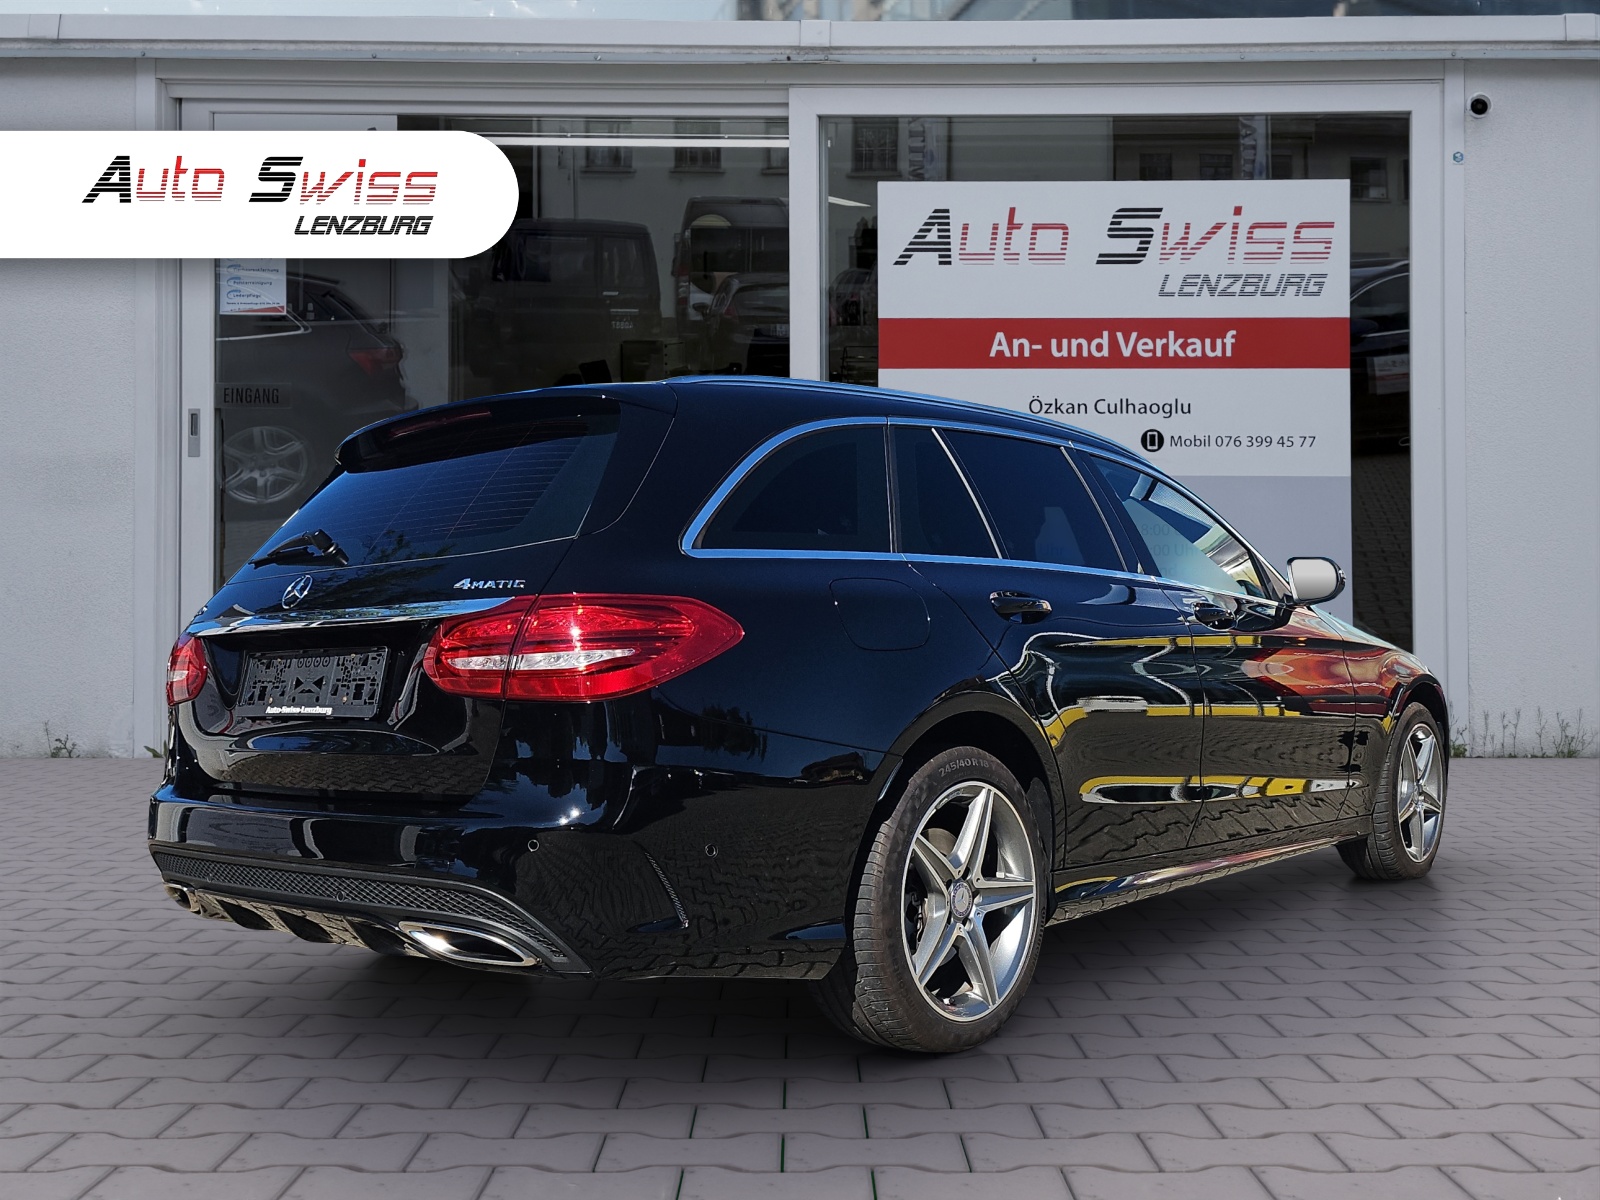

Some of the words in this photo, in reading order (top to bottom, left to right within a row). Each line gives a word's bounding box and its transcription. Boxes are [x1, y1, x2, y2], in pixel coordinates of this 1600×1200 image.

[893, 206, 1070, 266] Auto
[1095, 205, 1336, 265] Swiss
[1158, 273, 1329, 298] LENZBURG
[989, 331, 1043, 358] An-
[1050, 331, 1109, 358] und
[1116, 330, 1237, 358] Verkauf
[223, 387, 279, 404] EINGANG
[1028, 395, 1088, 415] Özkan
[1094, 398, 1192, 419] Culhaoglu
[1169, 435, 1211, 448] Mobil
[1215, 435, 1242, 448] 076
[1246, 435, 1273, 448] 399
[1276, 435, 1295, 448] 45
[1299, 435, 1316, 448] 77
[453, 577, 526, 590] 4MATIC
